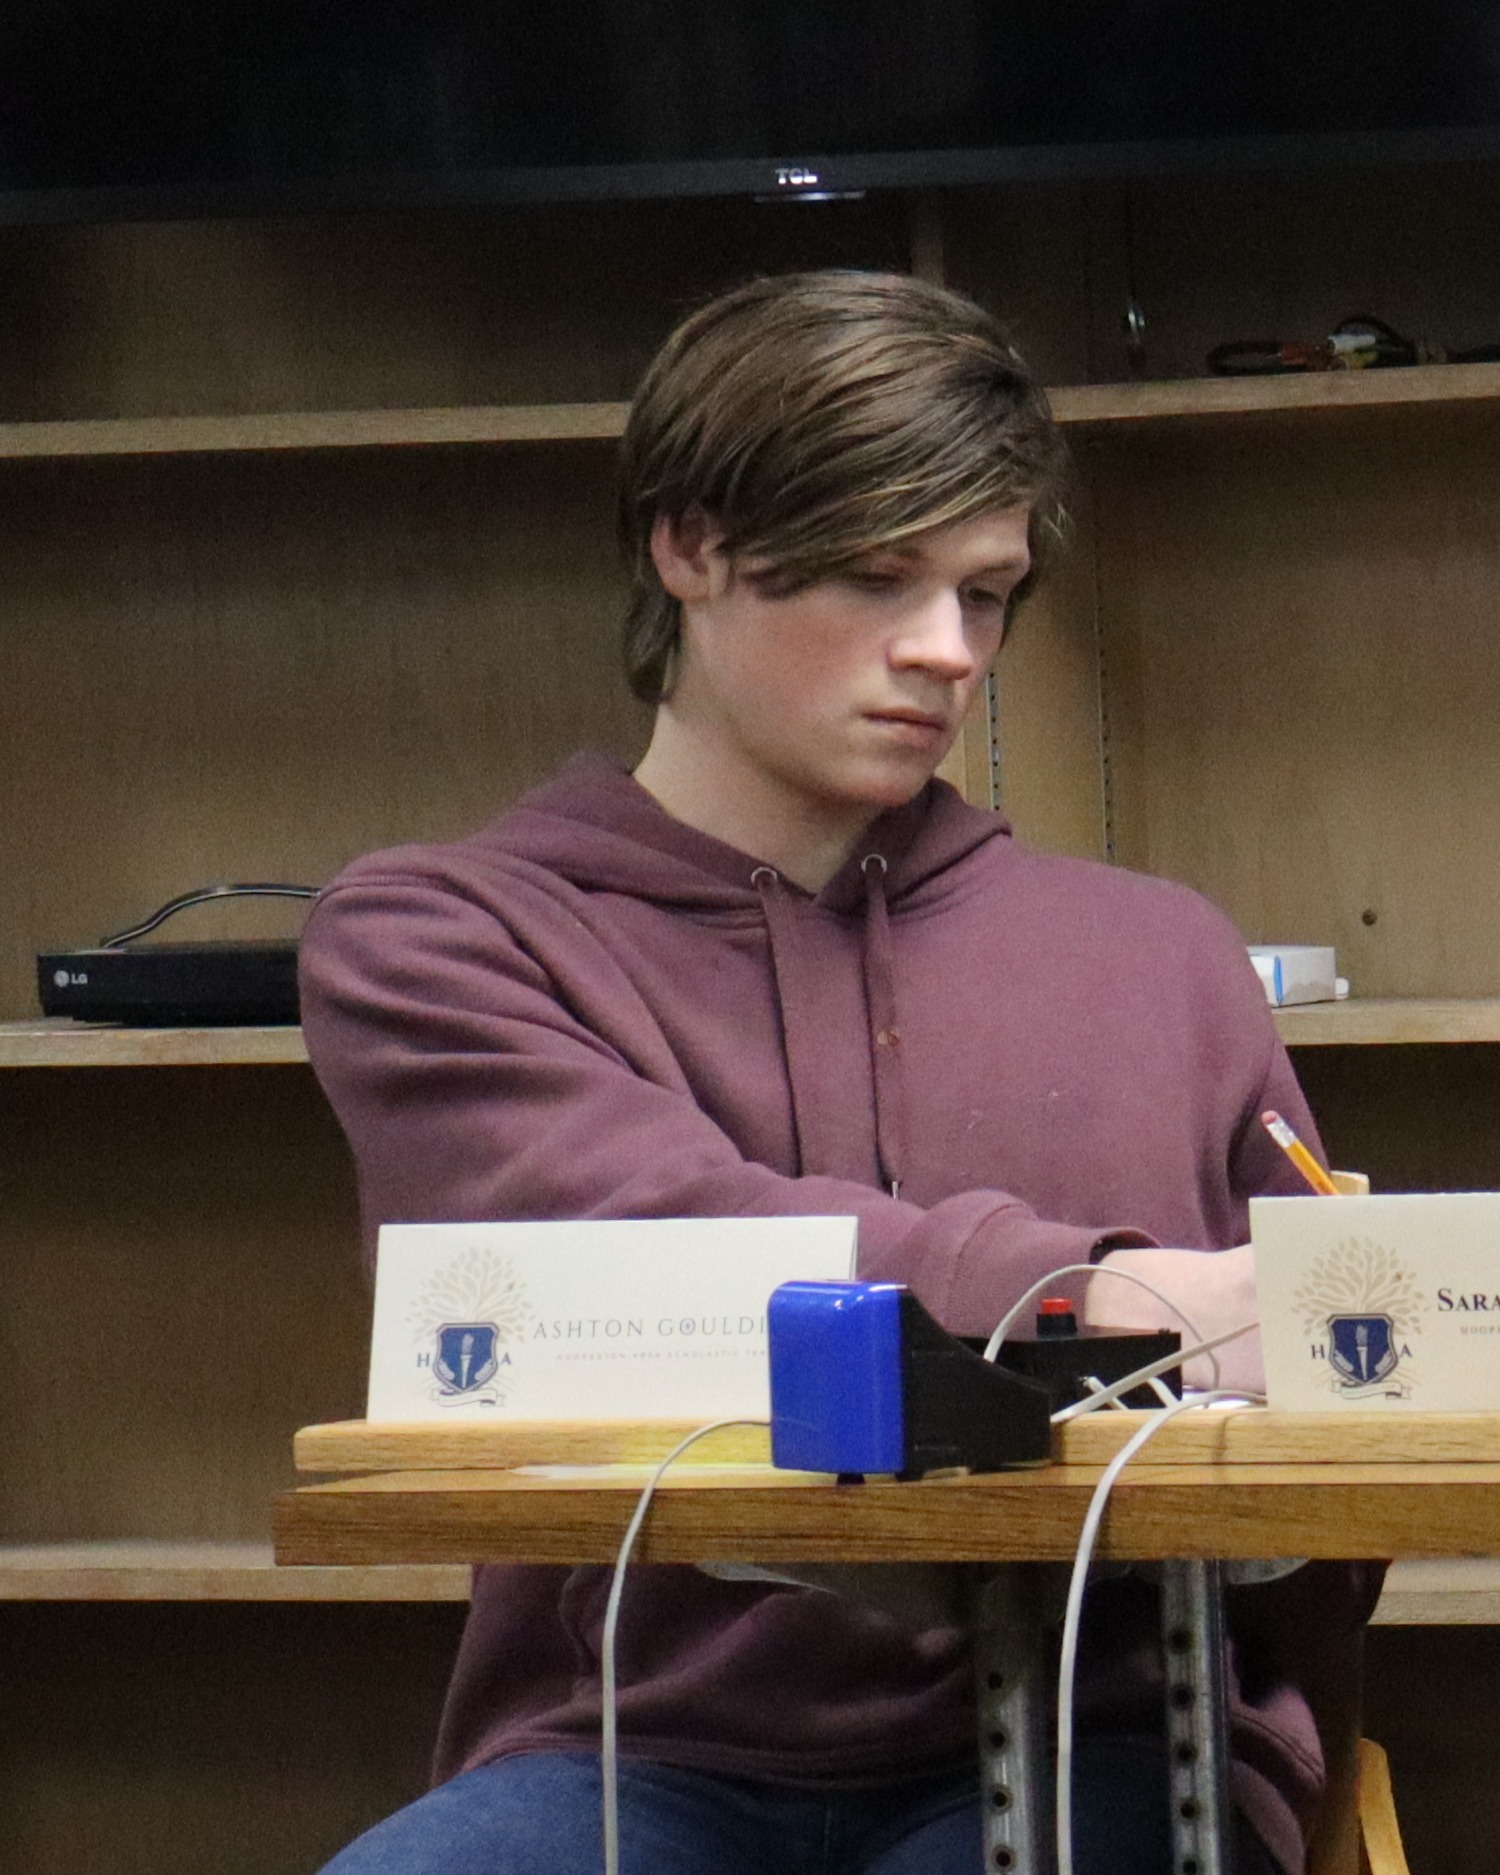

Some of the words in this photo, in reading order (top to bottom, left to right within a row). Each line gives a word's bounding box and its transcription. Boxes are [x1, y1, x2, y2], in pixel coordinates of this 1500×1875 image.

[775, 168, 817, 185] TCL
[71, 974, 88, 985] LG
[533, 1319, 644, 1340] ASHTON
[658, 1315, 768, 1337] GOULDI
[416, 1351, 431, 1368] H
[501, 1352, 514, 1367] A
[1310, 1344, 1327, 1360] H
[1399, 1343, 1413, 1359] A
